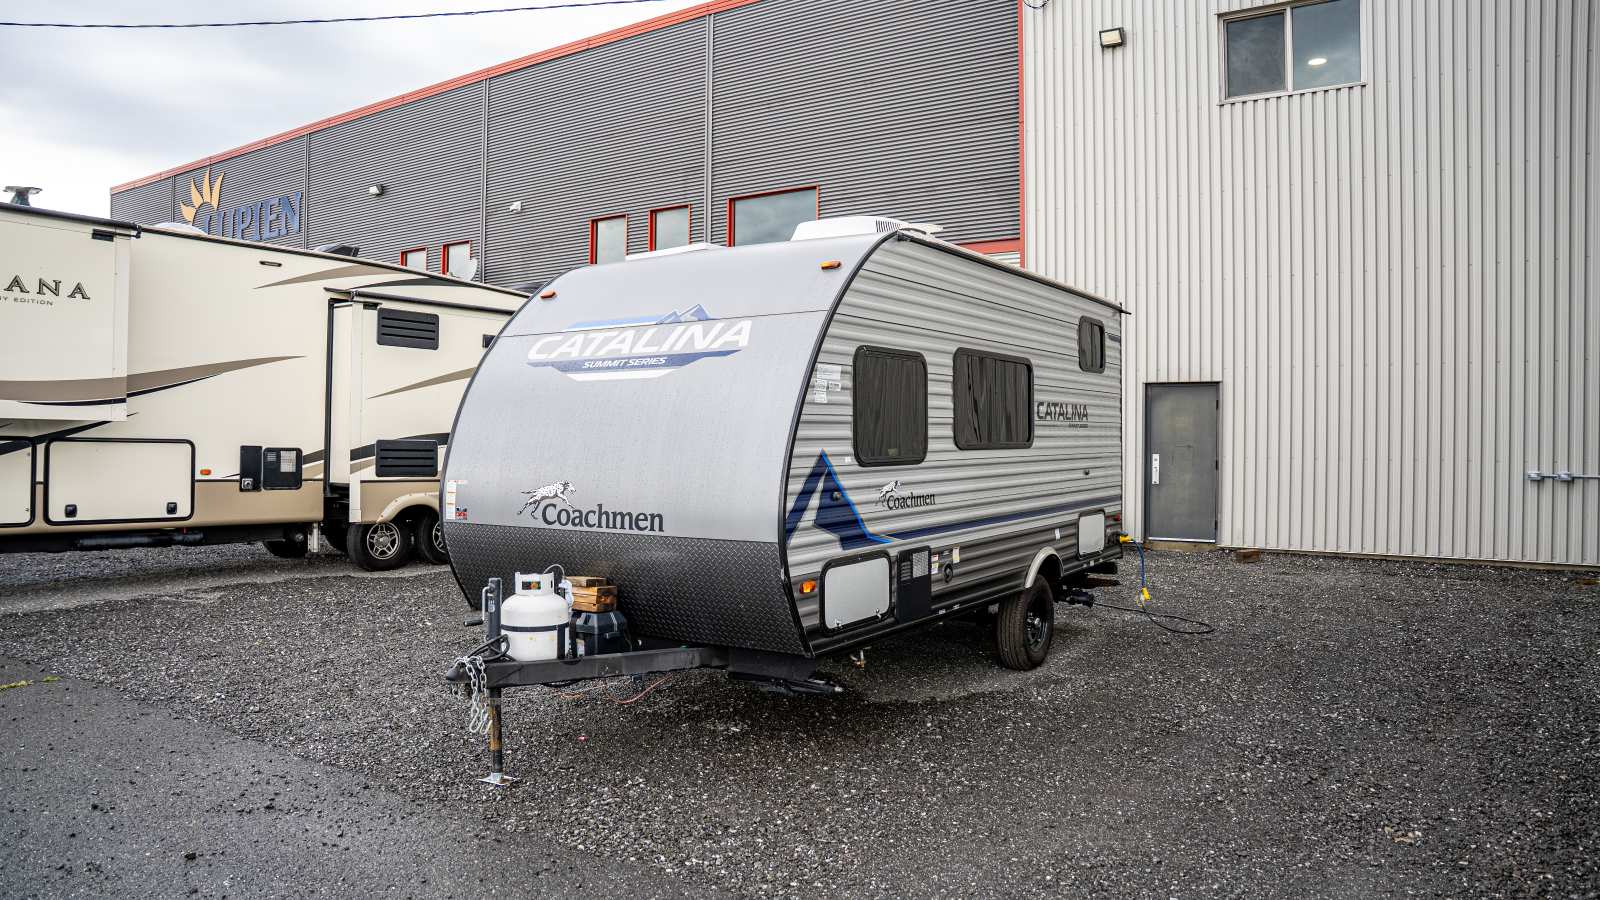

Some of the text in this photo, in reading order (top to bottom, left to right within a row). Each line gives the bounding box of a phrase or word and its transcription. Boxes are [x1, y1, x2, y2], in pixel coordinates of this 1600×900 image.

[202, 191, 302, 241] LUPIEN
[13, 297, 53, 306] EDITION
[527, 319, 753, 360] CATALINA
[582, 357, 667, 369] SUMMIT SERIES
[1036, 401, 1089, 421] CATALINA
[887, 491, 936, 510] Coachmen
[541, 503, 664, 532] Coachmen
